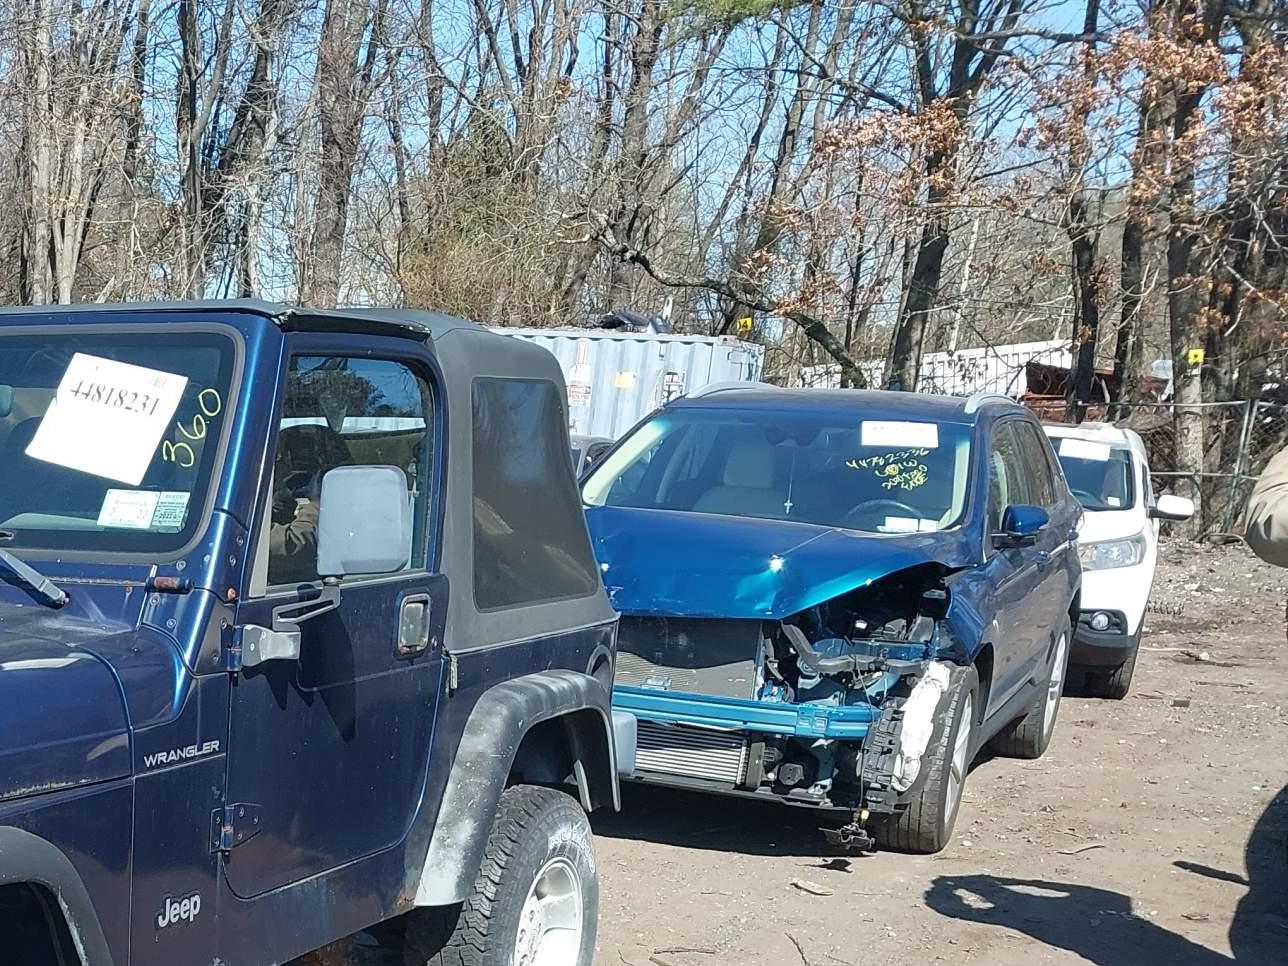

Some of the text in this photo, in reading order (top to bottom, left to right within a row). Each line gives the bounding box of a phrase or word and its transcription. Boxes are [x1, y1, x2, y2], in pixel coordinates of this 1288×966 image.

[70, 379, 160, 416] 44818231
[162, 387, 222, 468] 360
[144, 740, 220, 767] WRANGLER
[157, 894, 201, 928] Jeep
